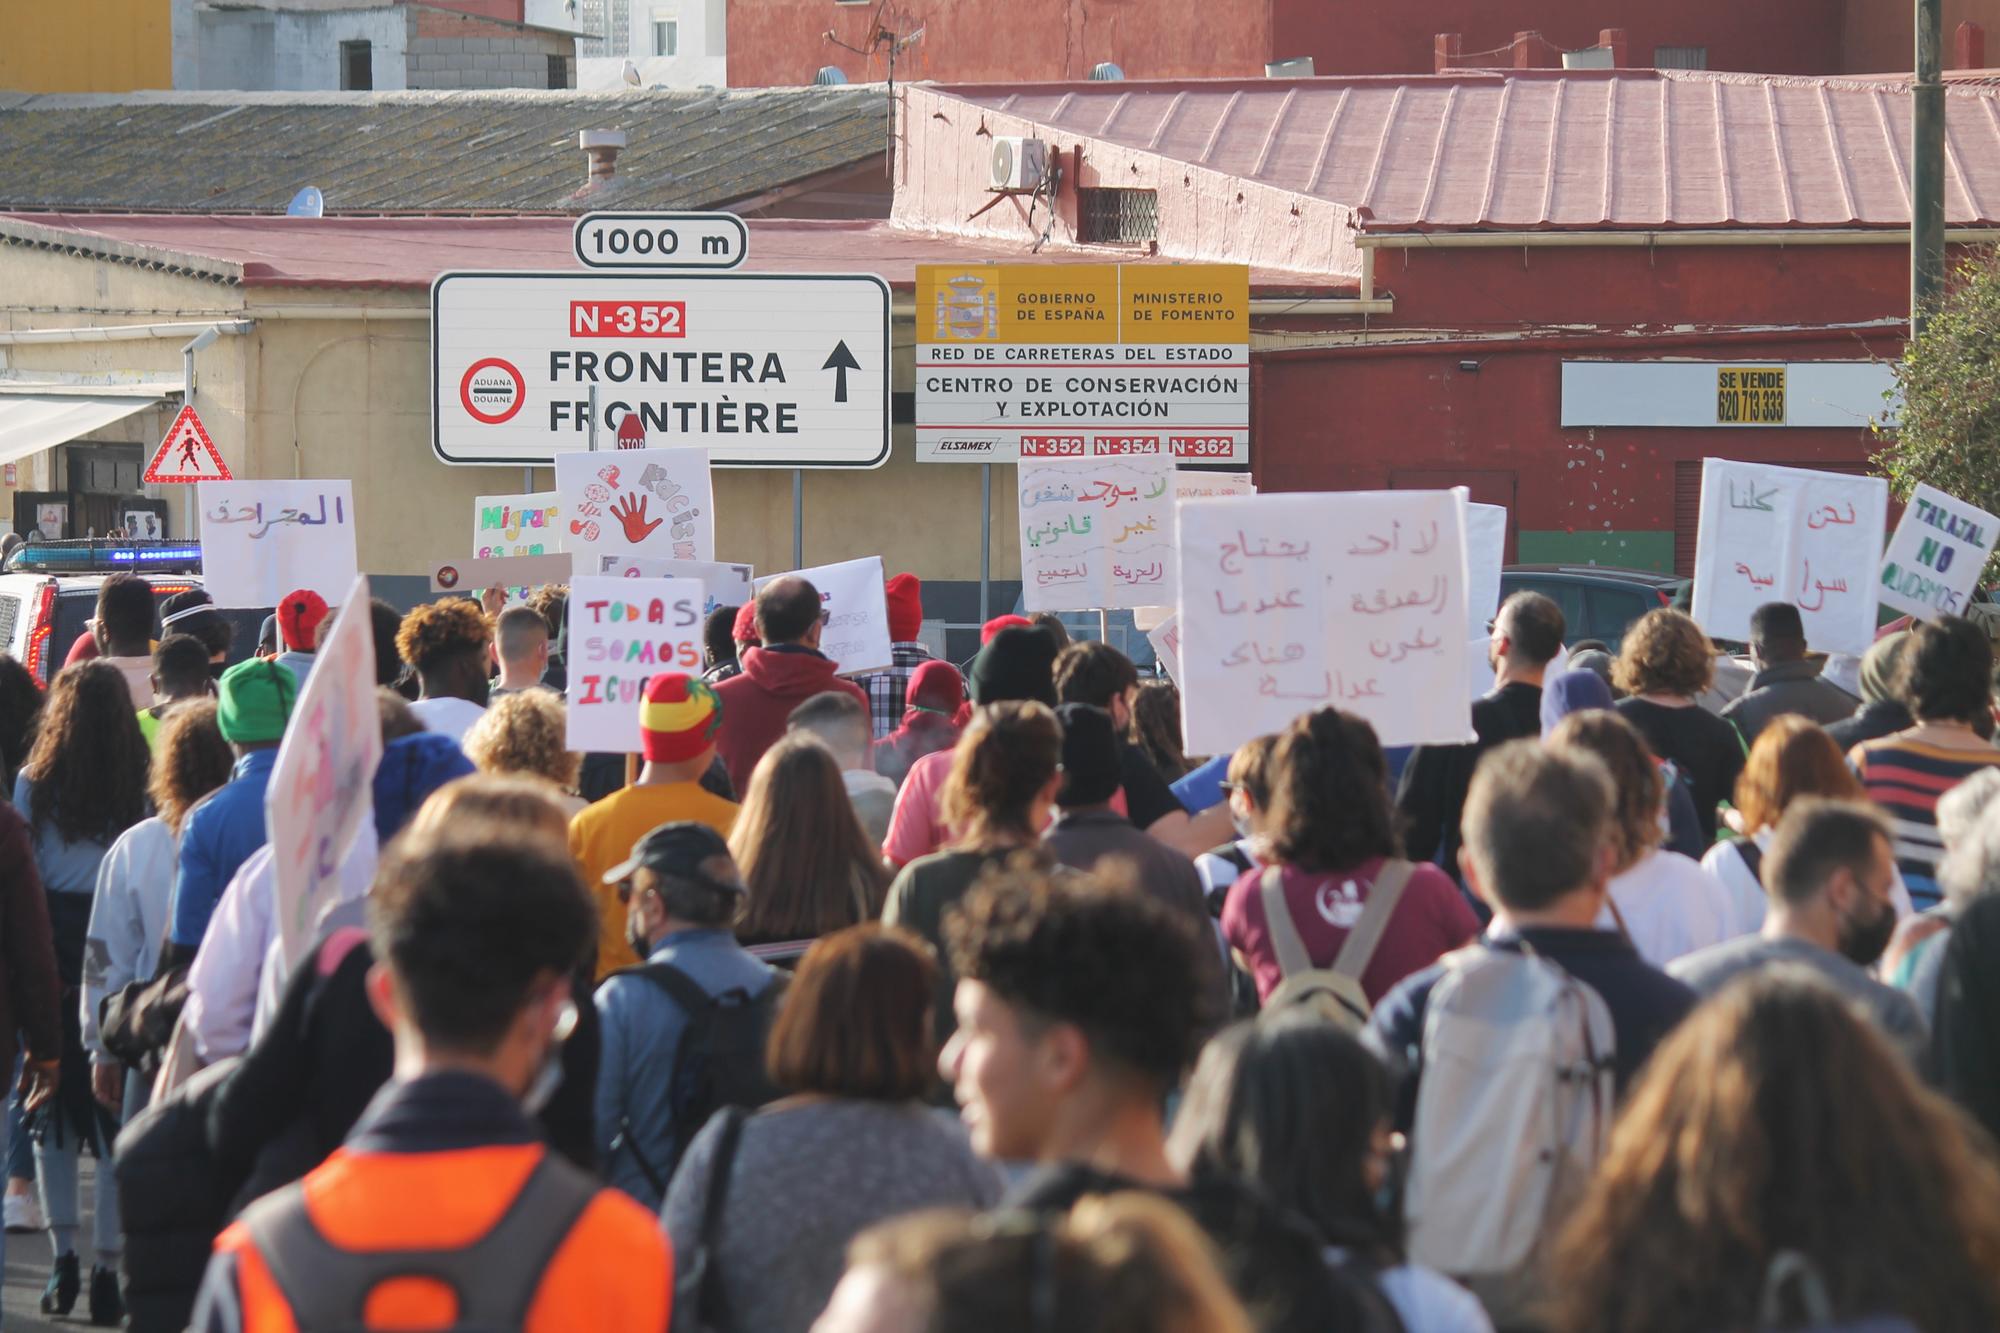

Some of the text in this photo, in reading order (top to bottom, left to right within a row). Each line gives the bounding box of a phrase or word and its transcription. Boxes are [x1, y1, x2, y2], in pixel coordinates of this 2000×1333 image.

[592, 228, 730, 255] 1000 m
[1016, 292, 1096, 305] GOBIERNO
[1133, 292, 1223, 305] MINISTERIO
[573, 305, 682, 334] N-352
[1016, 306, 1106, 321] DE ESPAÑA
[1133, 309, 1236, 321] DE FOMENTO
[931, 347, 1233, 361] RED DE CARRETERAS DEL ESTADO
[549, 350, 787, 385] FRONTERA
[474, 378, 512, 386] ADUANA
[926, 374, 1239, 394] CENTRO DE CONSERVACIÓN
[1719, 371, 1784, 389] SE VENDE
[473, 395, 512, 404] DOUANE
[996, 398, 1169, 417] Y EXPLOTACIÓN
[1718, 390, 1784, 421] 620 713 333
[549, 394, 799, 433] FRONTIÈRE
[618, 438, 645, 450] STOP
[939, 441, 993, 452] ELSAMEX
[1022, 438, 1083, 454] N-352
[1095, 438, 1157, 455] N-354
[1171, 439, 1232, 456] N-362
[1077, 480, 1138, 509] يوجد
[1144, 477, 1167, 499] لا
[1728, 479, 1857, 529] نحن كلنا
[481, 505, 559, 542] Migrar
[1026, 513, 1157, 548] غير قانوني
[1915, 497, 1985, 549] TARAJAL
[1219, 519, 1439, 576] لا أحد يحتاج
[1915, 535, 1956, 574] NO
[1036, 562, 1164, 585] الحرية للجميع
[585, 597, 698, 627] TODAS
[585, 636, 699, 668] SOMOS
[578, 675, 650, 705] IGU
[1258, 671, 1387, 701] عدالة
